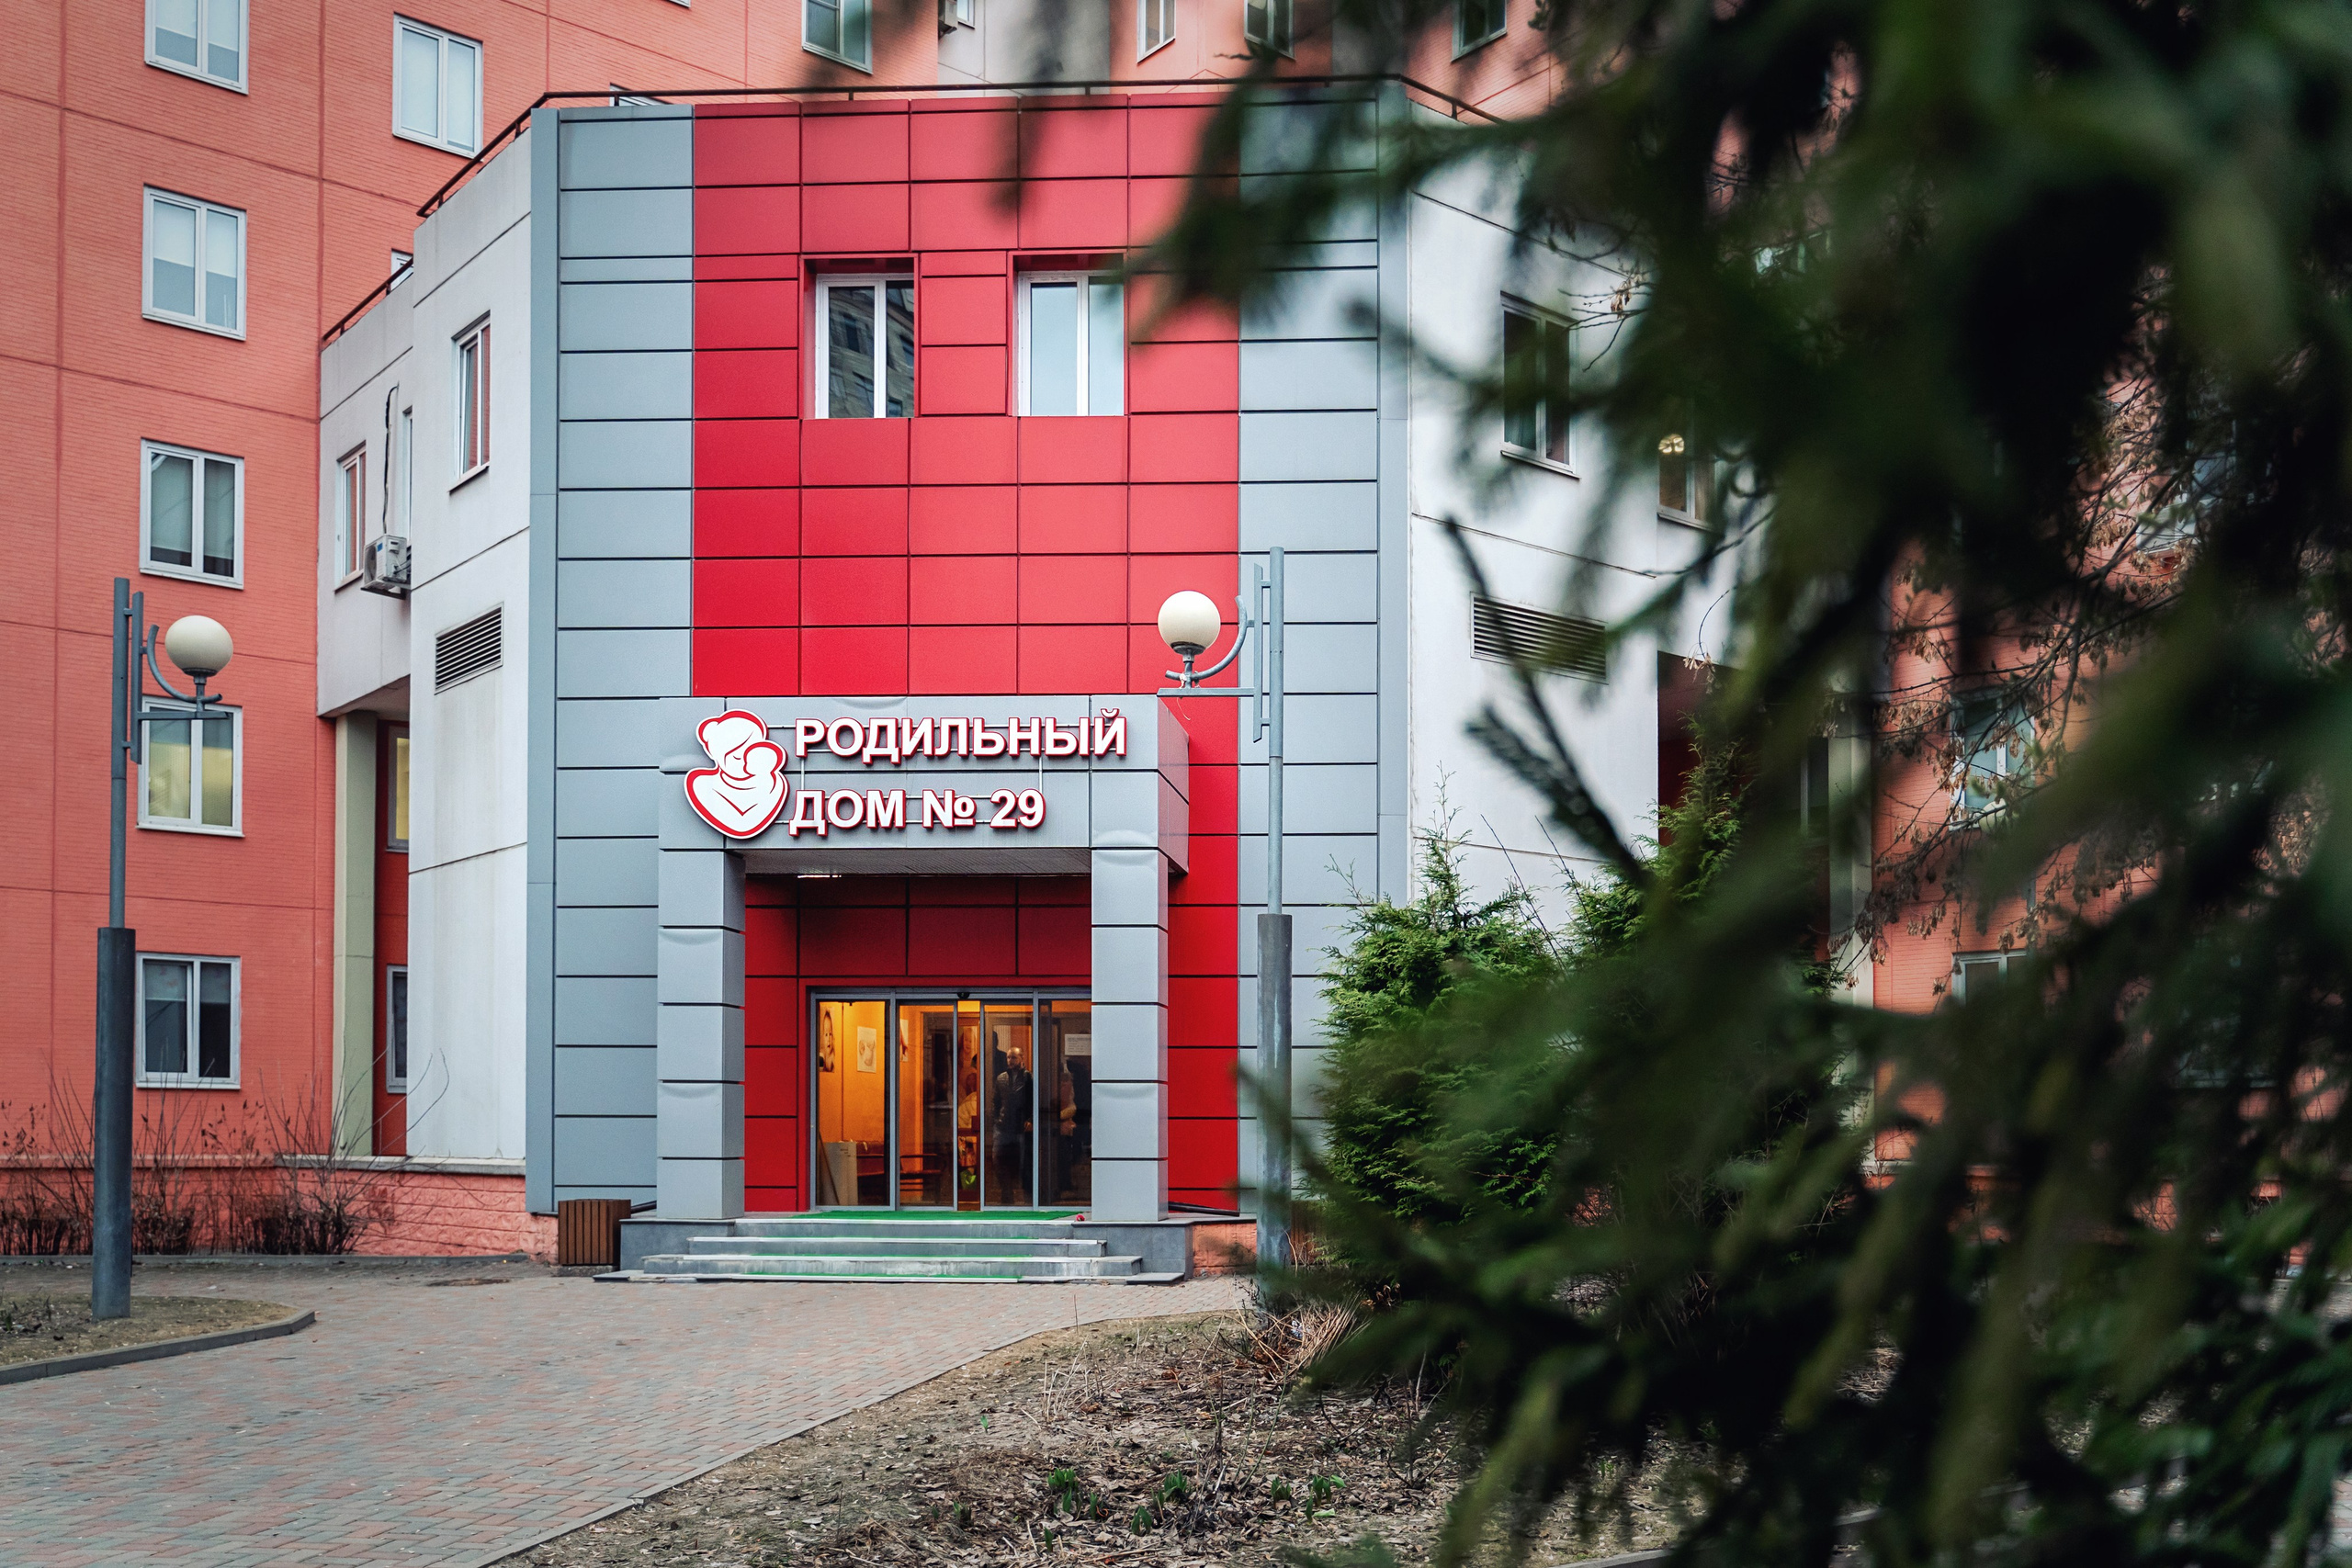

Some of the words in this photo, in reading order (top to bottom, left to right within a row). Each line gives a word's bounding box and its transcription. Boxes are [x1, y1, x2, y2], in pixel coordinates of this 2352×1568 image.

[795, 707, 1127, 763] РОДИЛЬНЫЙ
[788, 788, 907, 836] ДОМ
[922, 788, 976, 829] №
[989, 787, 1045, 829] 29
